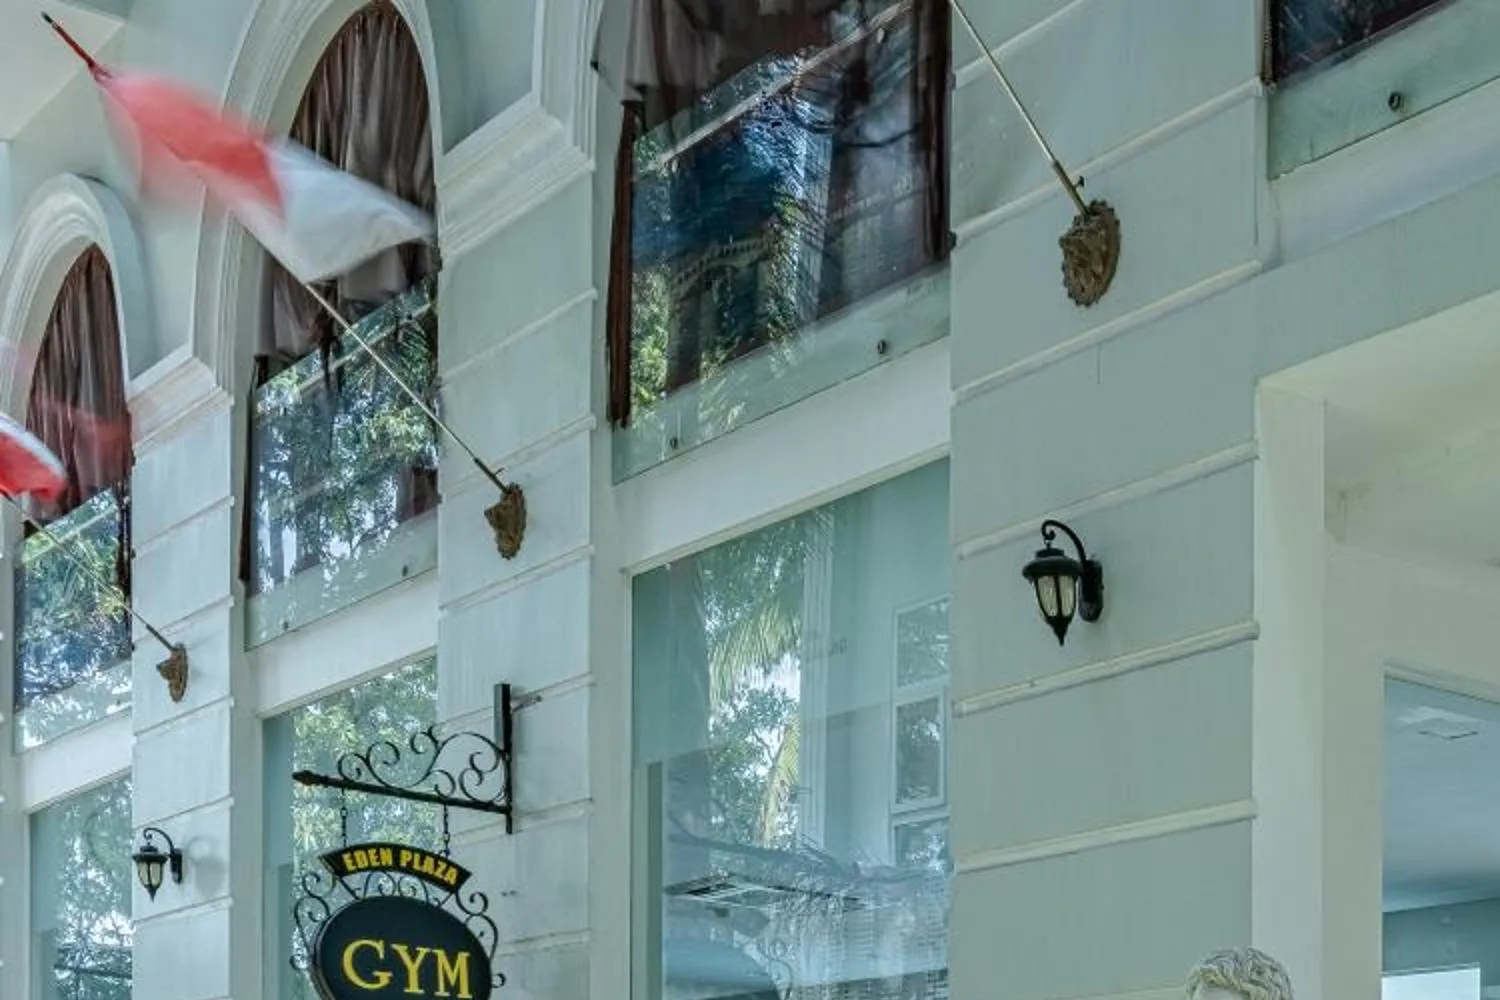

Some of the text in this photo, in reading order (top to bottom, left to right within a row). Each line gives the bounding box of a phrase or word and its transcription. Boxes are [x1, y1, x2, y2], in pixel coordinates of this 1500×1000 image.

[342, 848, 458, 885] EDEN PLAZA
[341, 938, 473, 999] GYM
